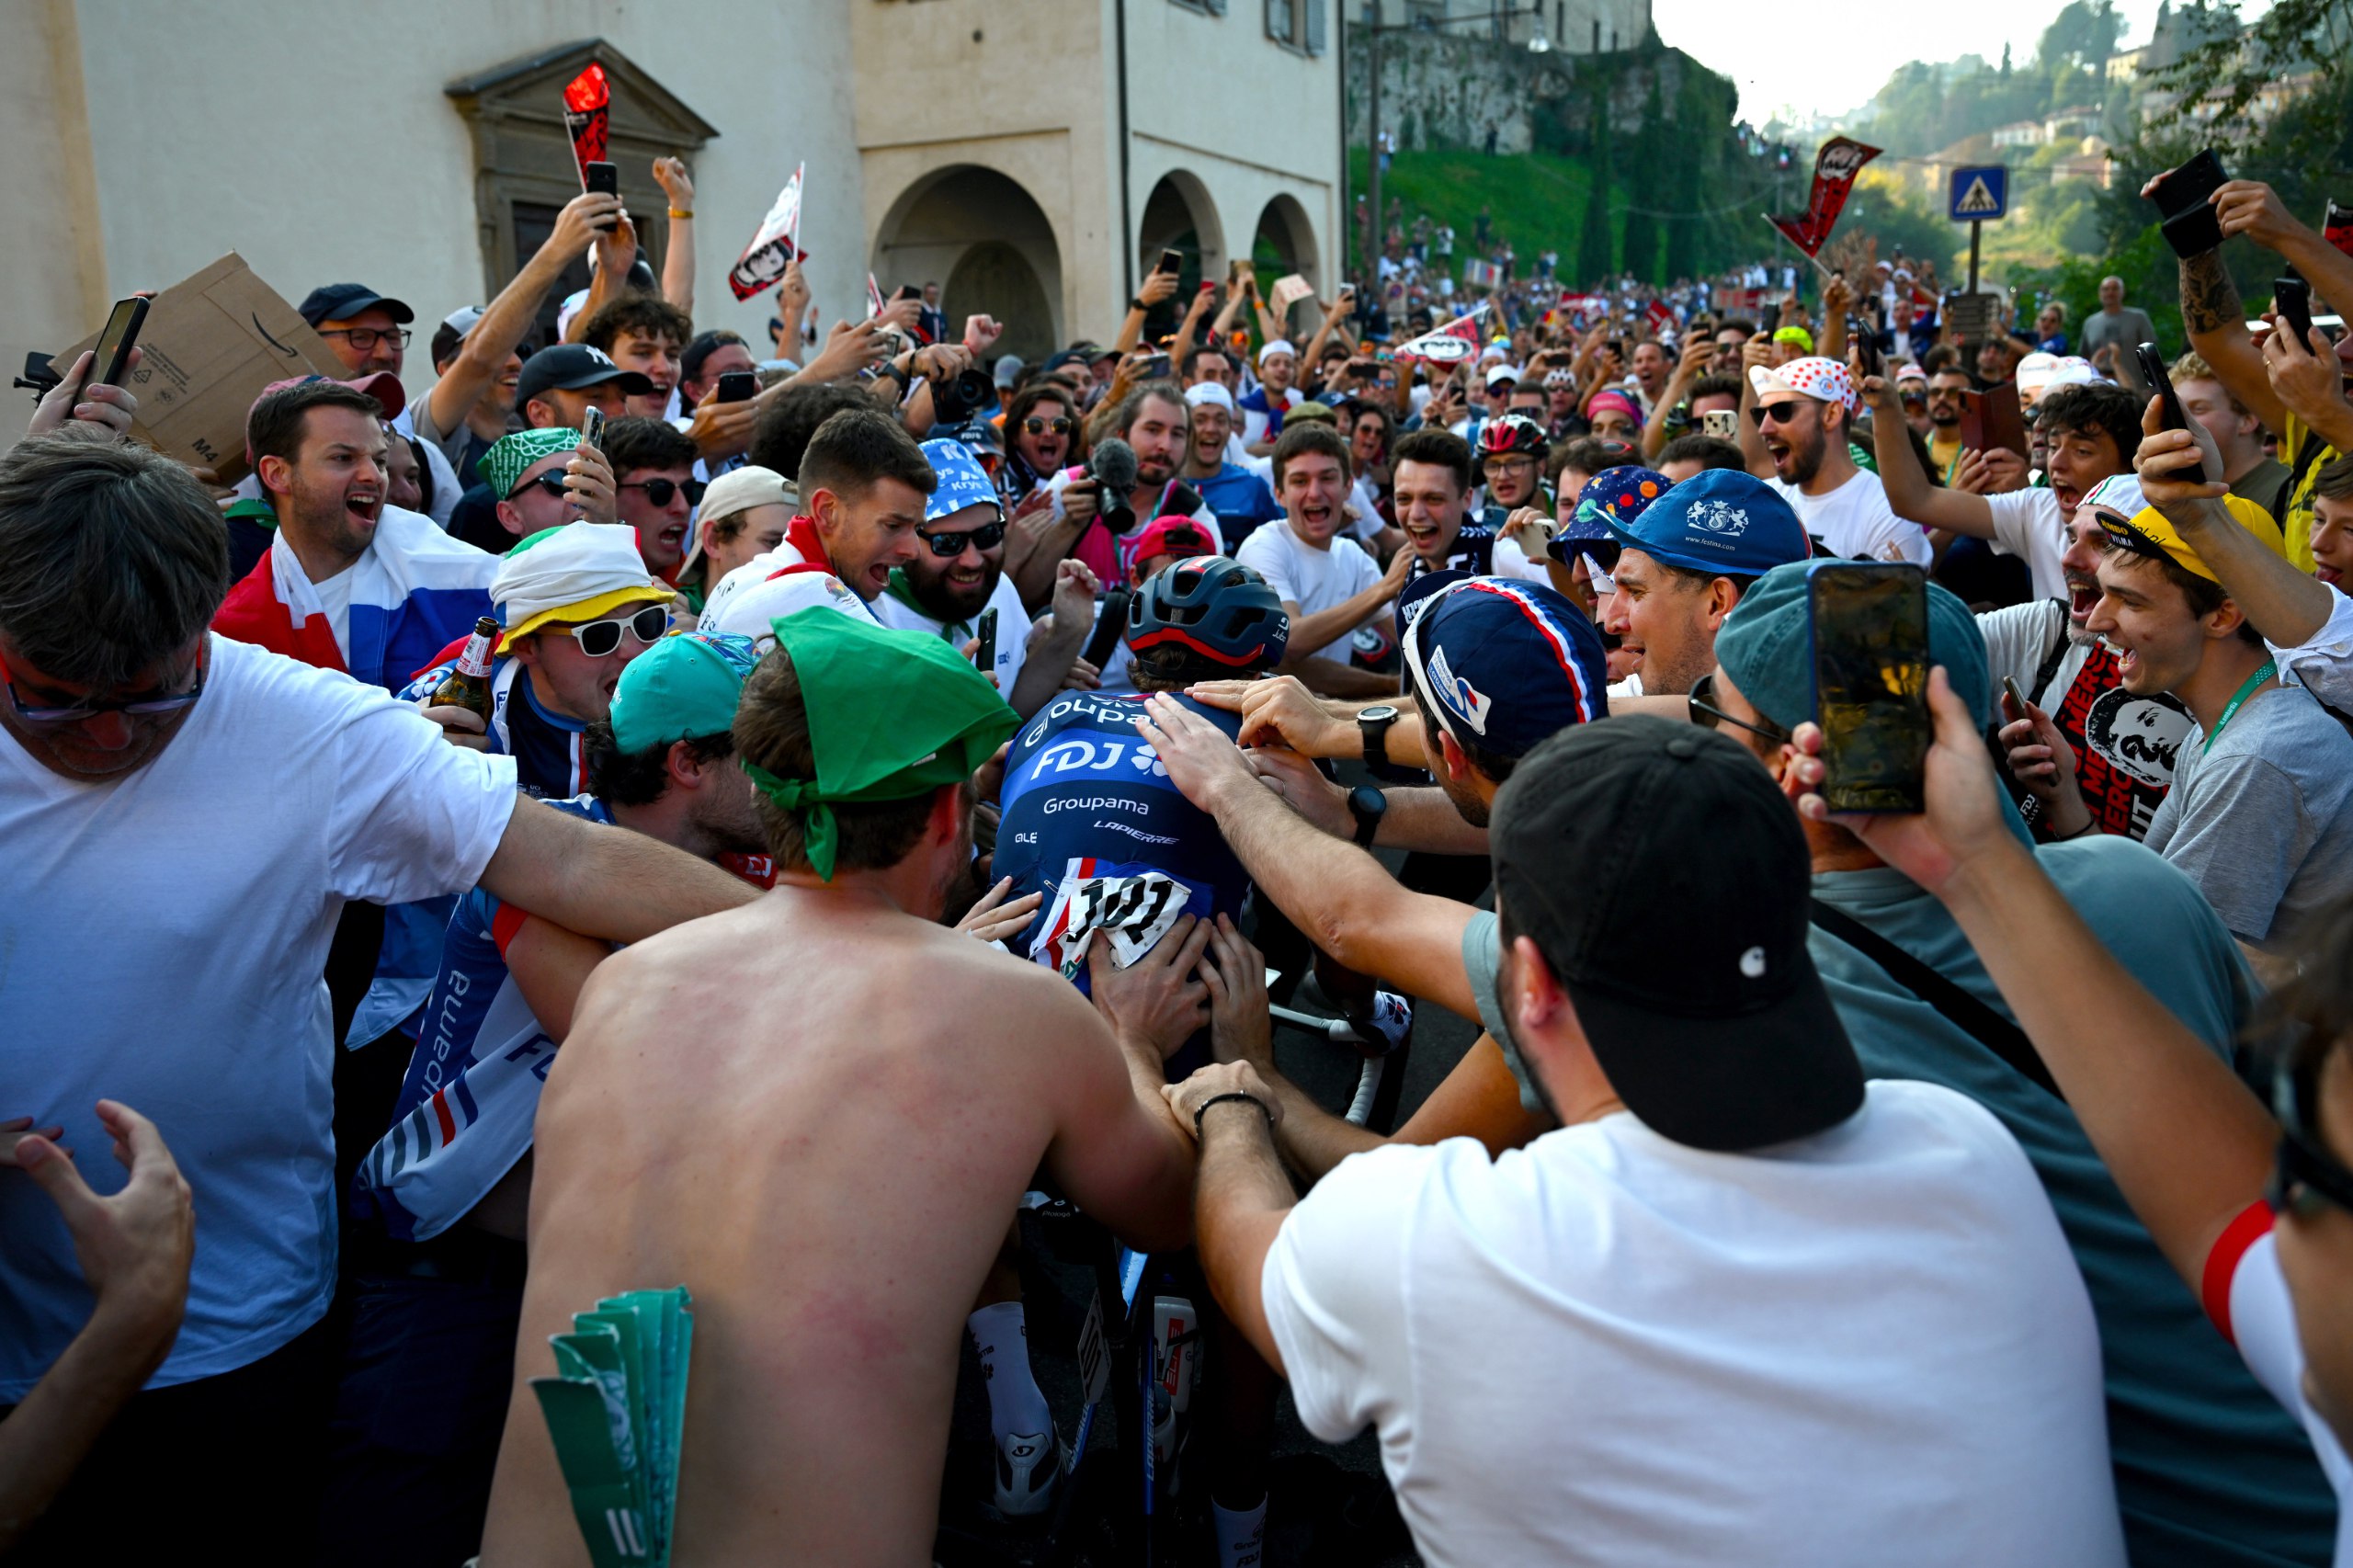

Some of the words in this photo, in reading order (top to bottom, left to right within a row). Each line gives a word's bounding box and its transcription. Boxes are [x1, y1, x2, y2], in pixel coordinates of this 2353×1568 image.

[192, 437, 219, 462] M4
[951, 481, 983, 491] Krys
[1685, 535, 1735, 551] www.festina.com
[2110, 534, 2134, 547] VISMA
[1025, 699, 1154, 748] Groupa
[1030, 740, 1126, 781] FDJ
[1043, 797, 1150, 815] Groupama
[2019, 793, 2036, 816] FDJ
[1093, 820, 1180, 846] LAPIERRE
[1066, 875, 1175, 945] 101
[1144, 1385, 1156, 1482] LAPIERRE
